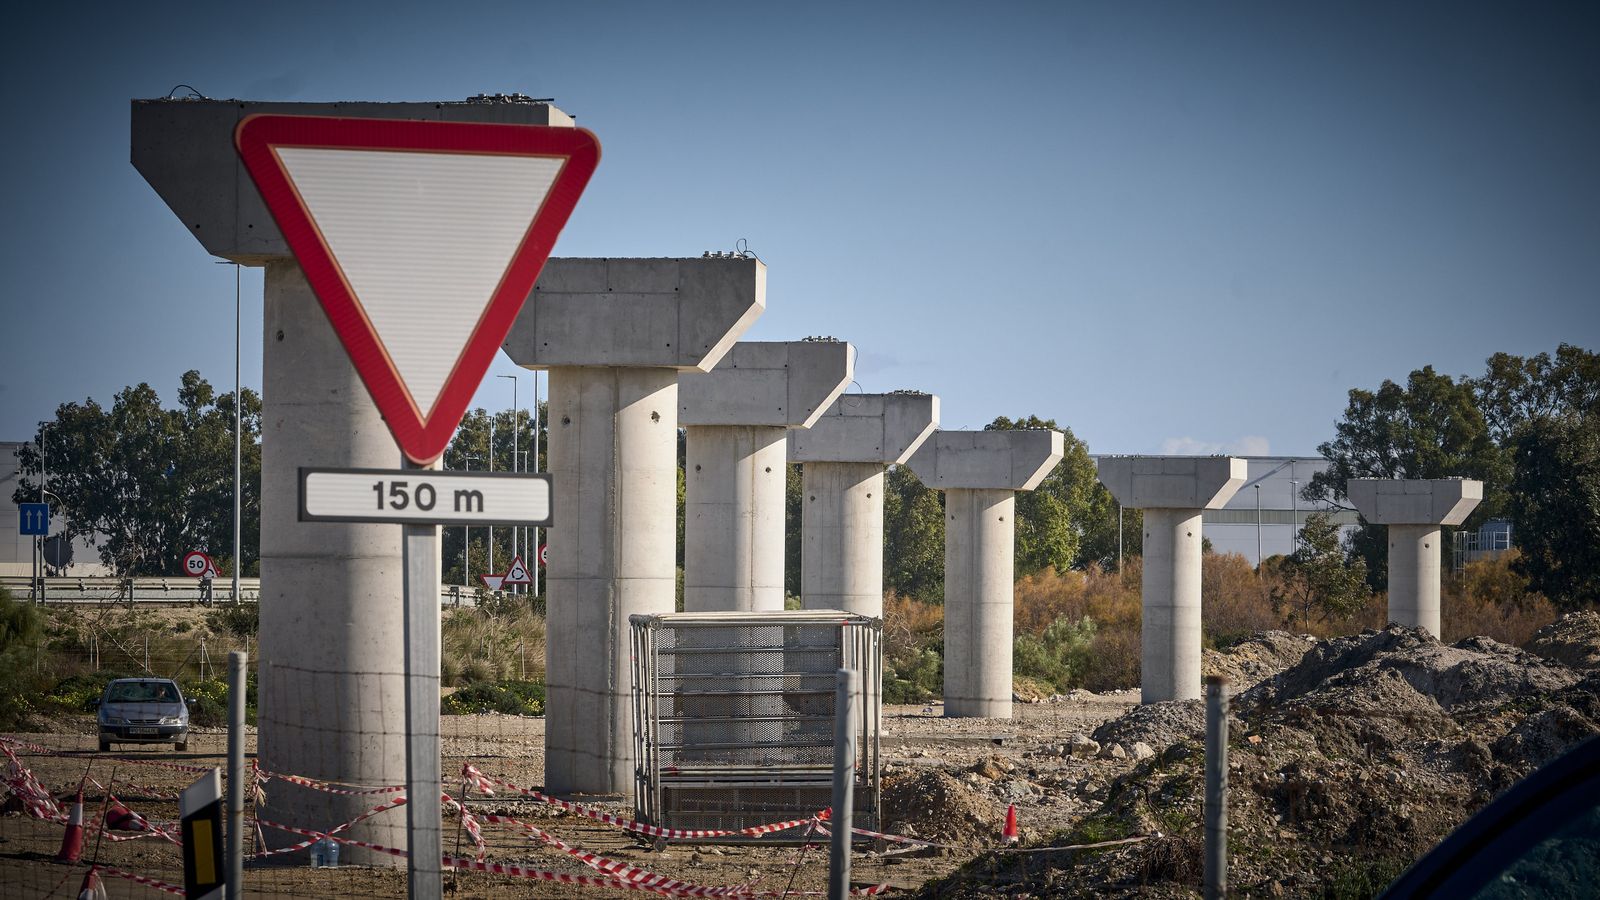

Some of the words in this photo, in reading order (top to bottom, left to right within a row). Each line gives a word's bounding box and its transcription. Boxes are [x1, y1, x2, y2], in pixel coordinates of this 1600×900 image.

[373, 481, 437, 512] 150
[454, 489, 484, 513] m
[189, 560, 204, 569] 50
